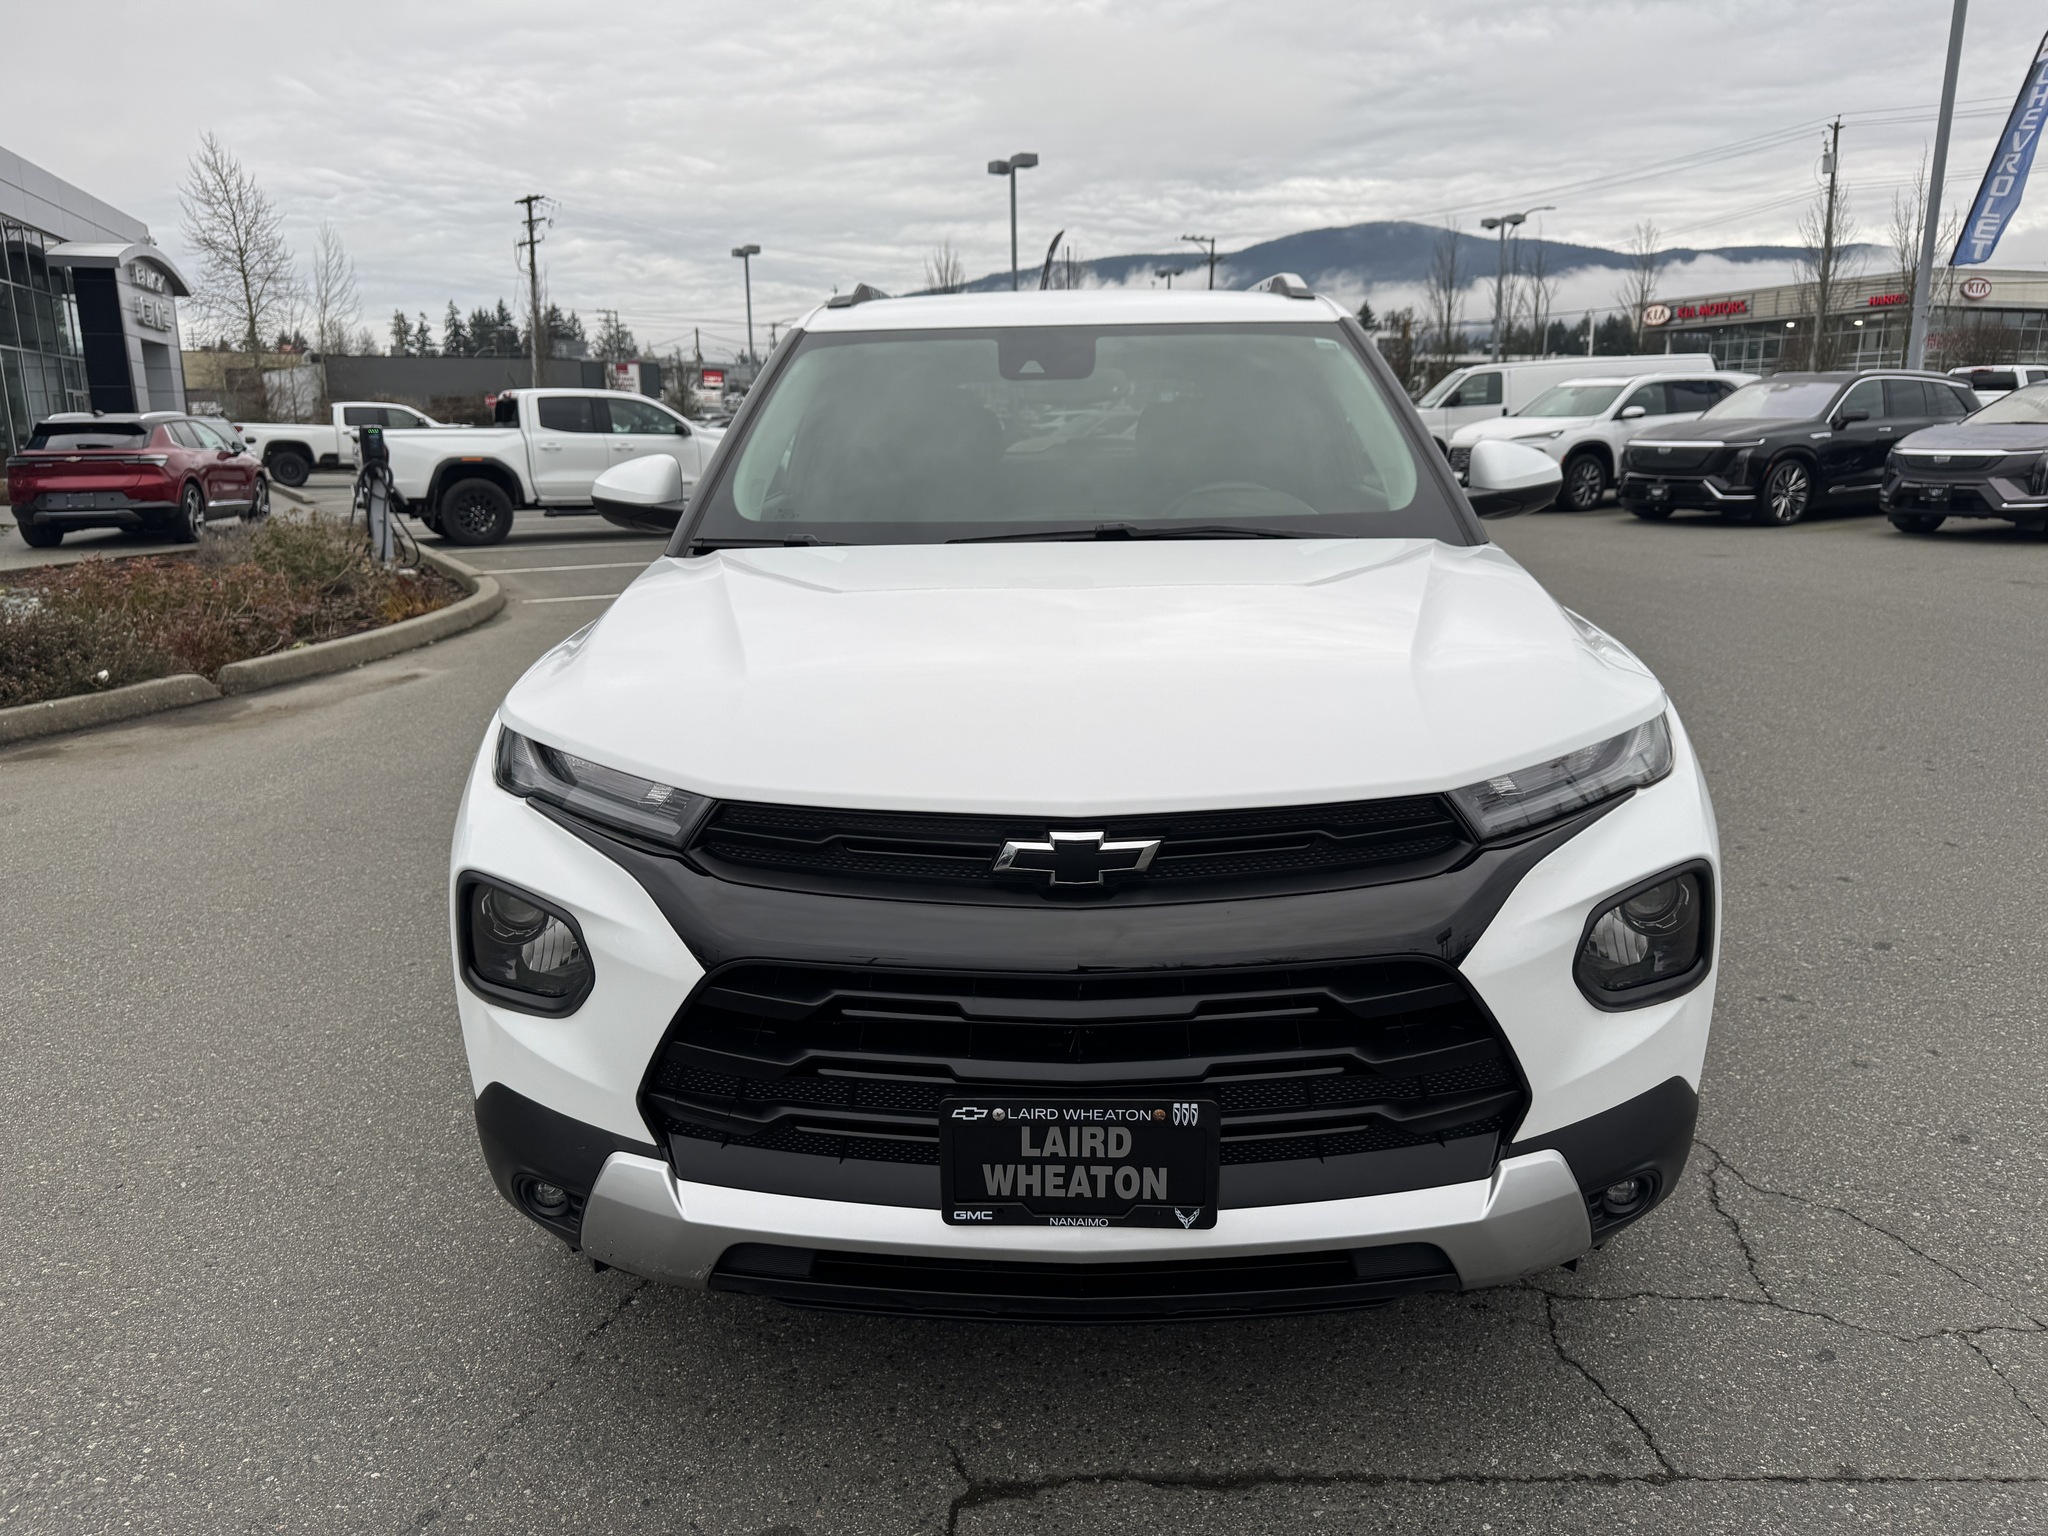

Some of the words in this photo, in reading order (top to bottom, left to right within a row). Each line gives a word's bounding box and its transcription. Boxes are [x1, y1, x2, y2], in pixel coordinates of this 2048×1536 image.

[1968, 283, 1987, 293] KIA
[1678, 306, 1696, 318] KIA
[1698, 301, 1746, 316] MOTORS
[1008, 1108, 1058, 1120] LAIRD
[1063, 1109, 1151, 1121] WHEATON
[1021, 1126, 1132, 1158] LAIRD
[982, 1164, 1167, 1200] WHEATON
[953, 1211, 993, 1220] GMC
[1049, 1217, 1109, 1227] NANAIMO
